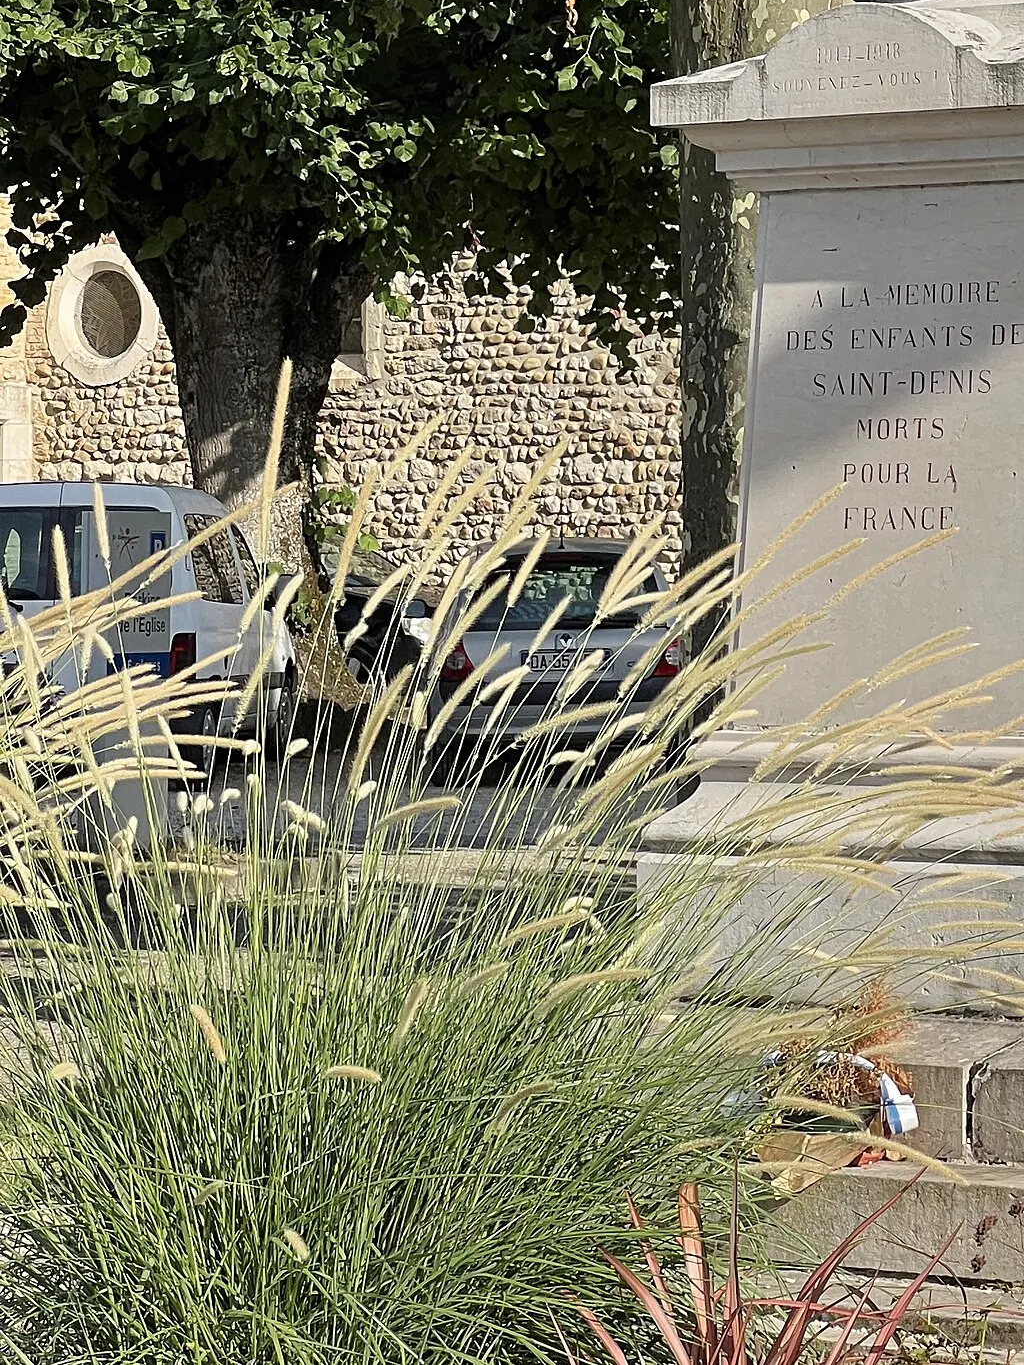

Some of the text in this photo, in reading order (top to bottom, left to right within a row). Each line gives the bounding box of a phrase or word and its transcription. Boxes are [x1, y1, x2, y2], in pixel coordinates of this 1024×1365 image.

[811, 281, 1000, 308] A LA MEMOIRE
[786, 323, 1024, 351] DES ENFANTS DE
[812, 369, 993, 397] SAINT-DENIS
[856, 417, 945, 440] MORTS
[843, 463, 958, 484] POUR LA
[843, 506, 954, 531] FRANCE
